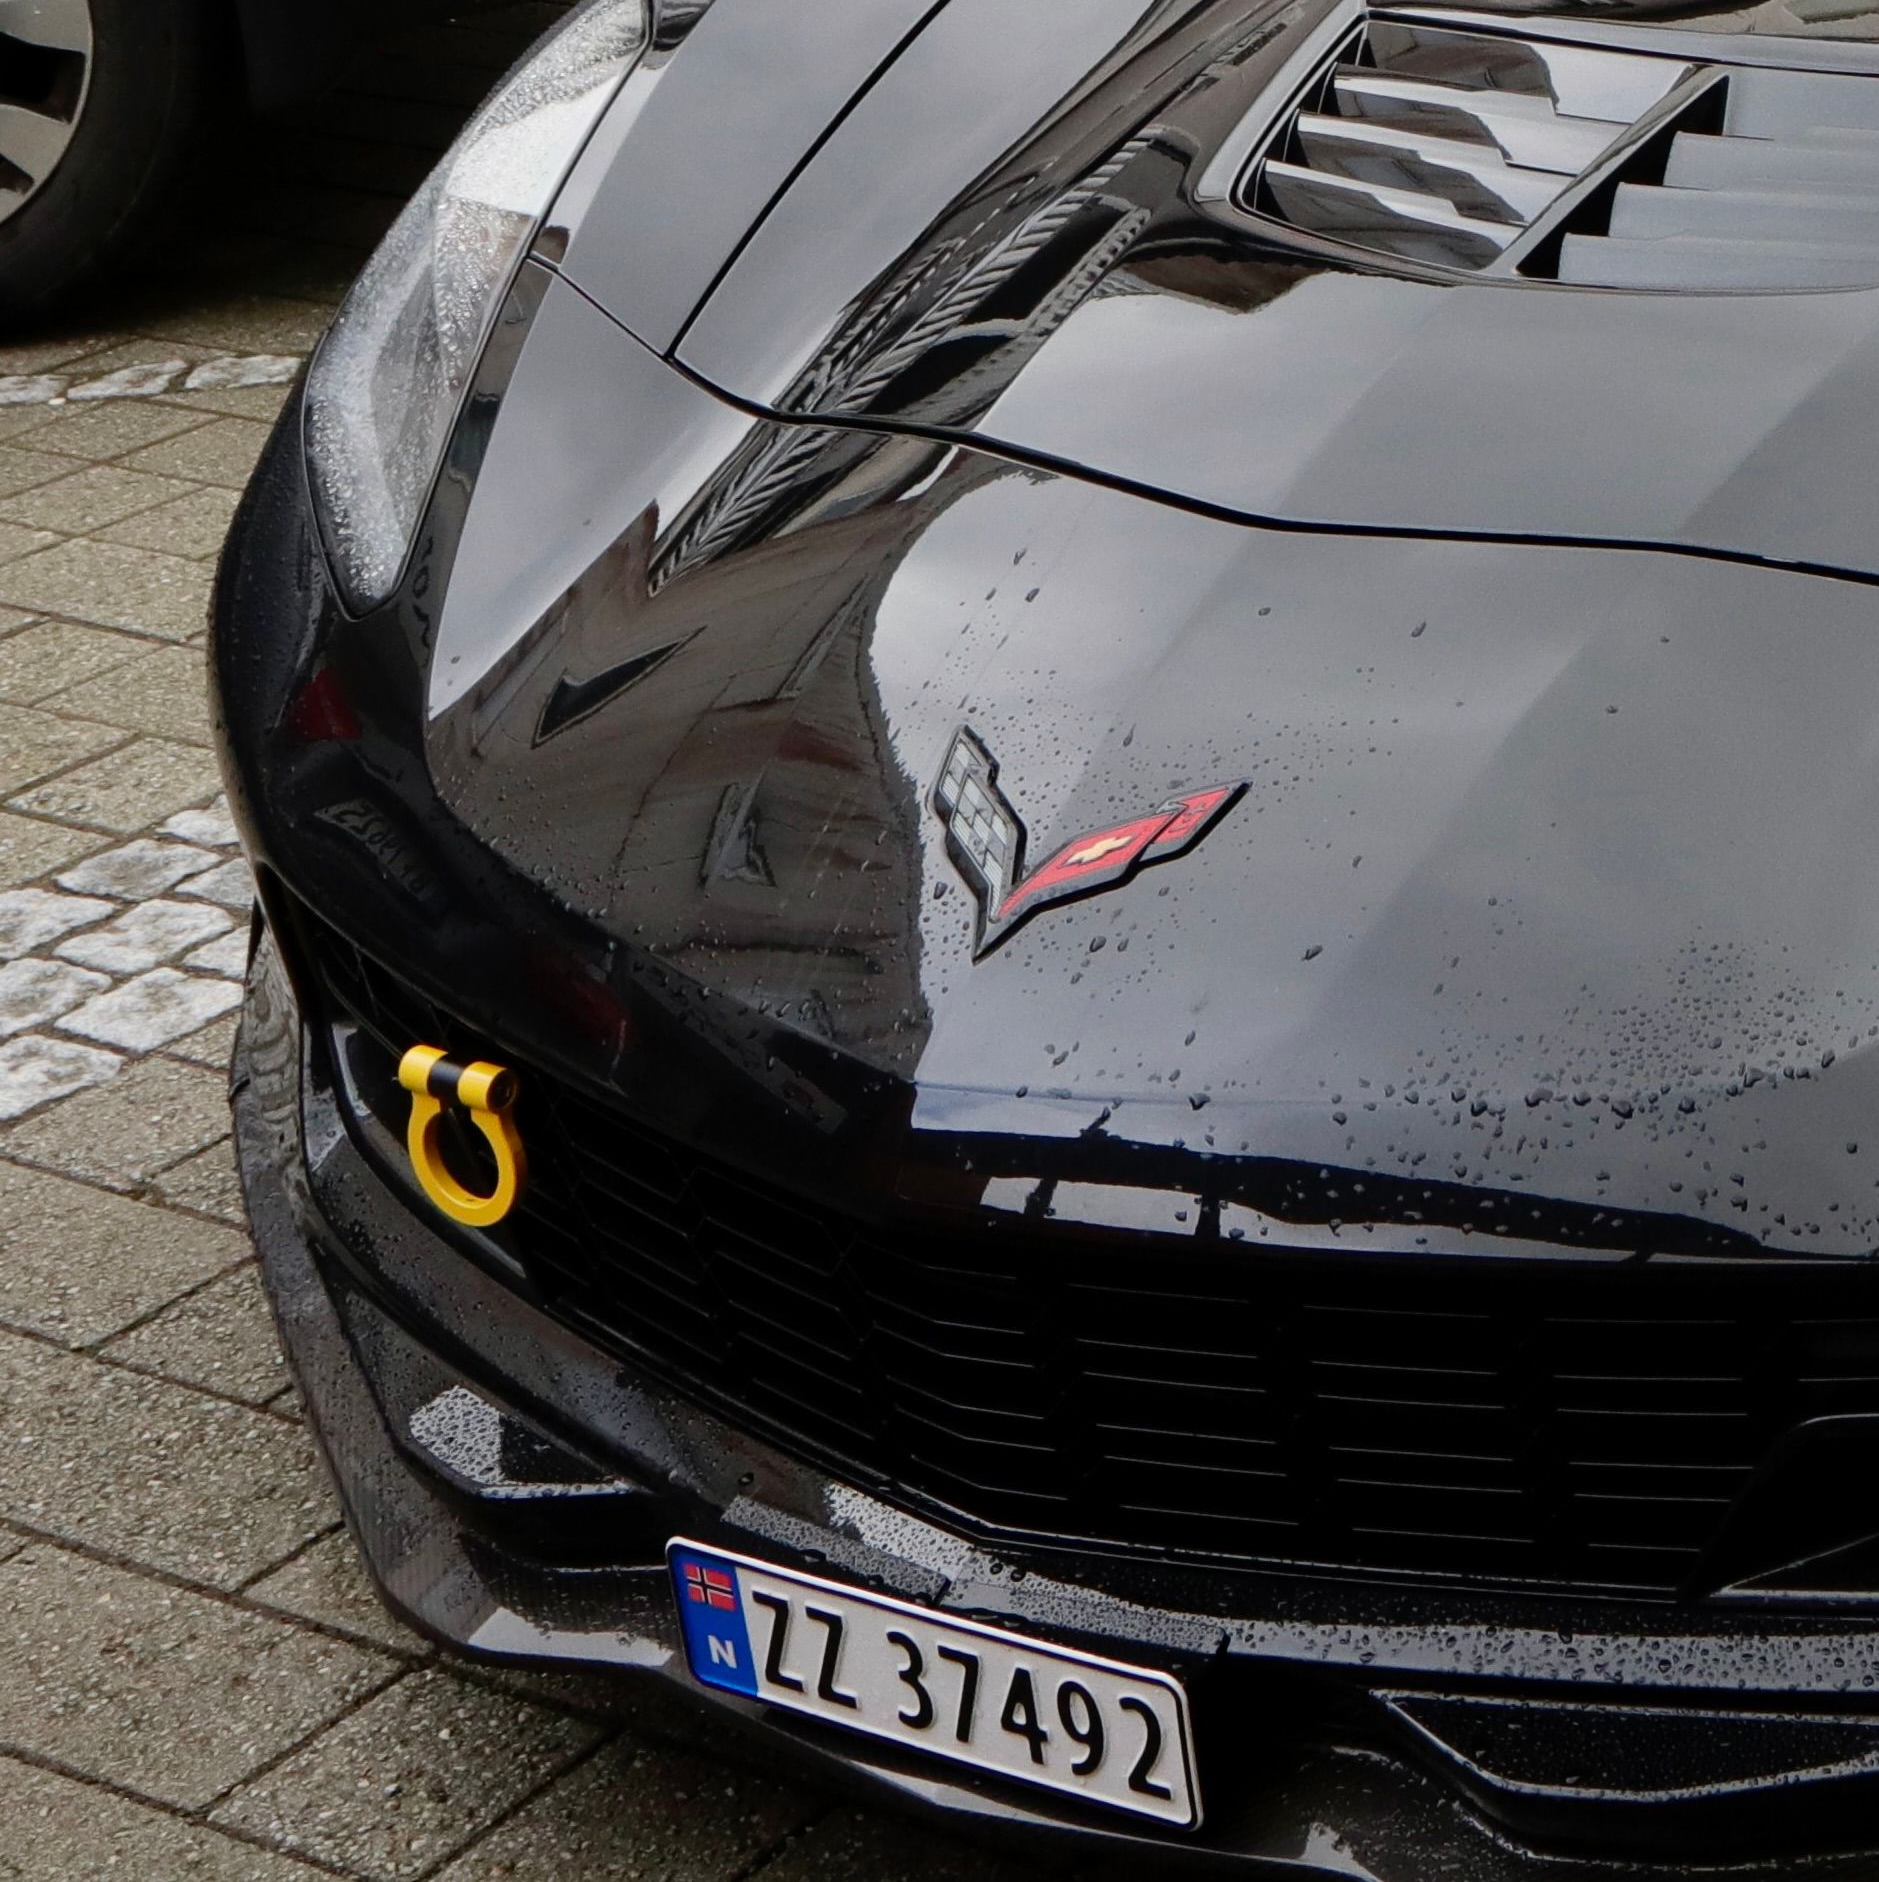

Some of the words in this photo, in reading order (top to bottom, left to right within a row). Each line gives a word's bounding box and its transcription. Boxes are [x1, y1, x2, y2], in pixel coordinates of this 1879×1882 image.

[706, 1633, 738, 1670] N
[751, 1589, 858, 1710] ZZ
[886, 1629, 1173, 1802] 37492
